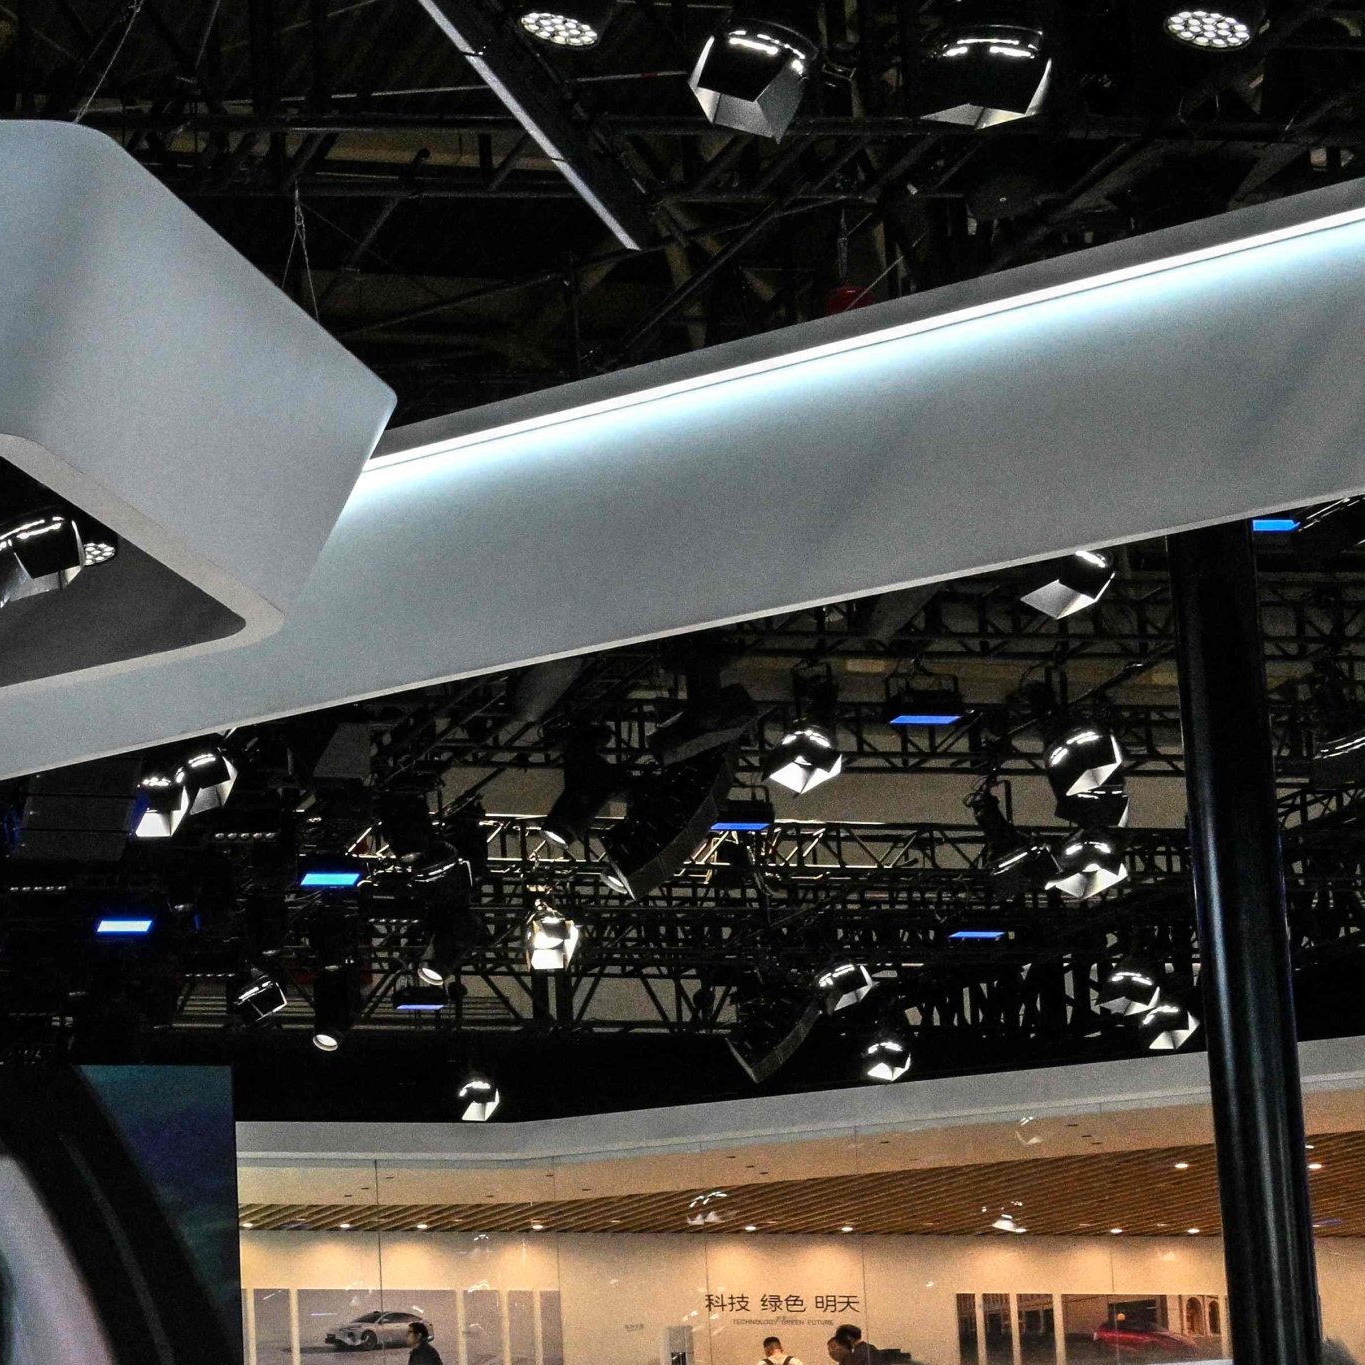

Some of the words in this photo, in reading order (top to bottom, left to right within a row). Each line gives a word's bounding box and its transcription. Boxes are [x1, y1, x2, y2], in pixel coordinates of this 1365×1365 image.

[704, 1293, 751, 1313] 科技
[760, 1293, 806, 1313] 绿色
[815, 1294, 860, 1313] 明天
